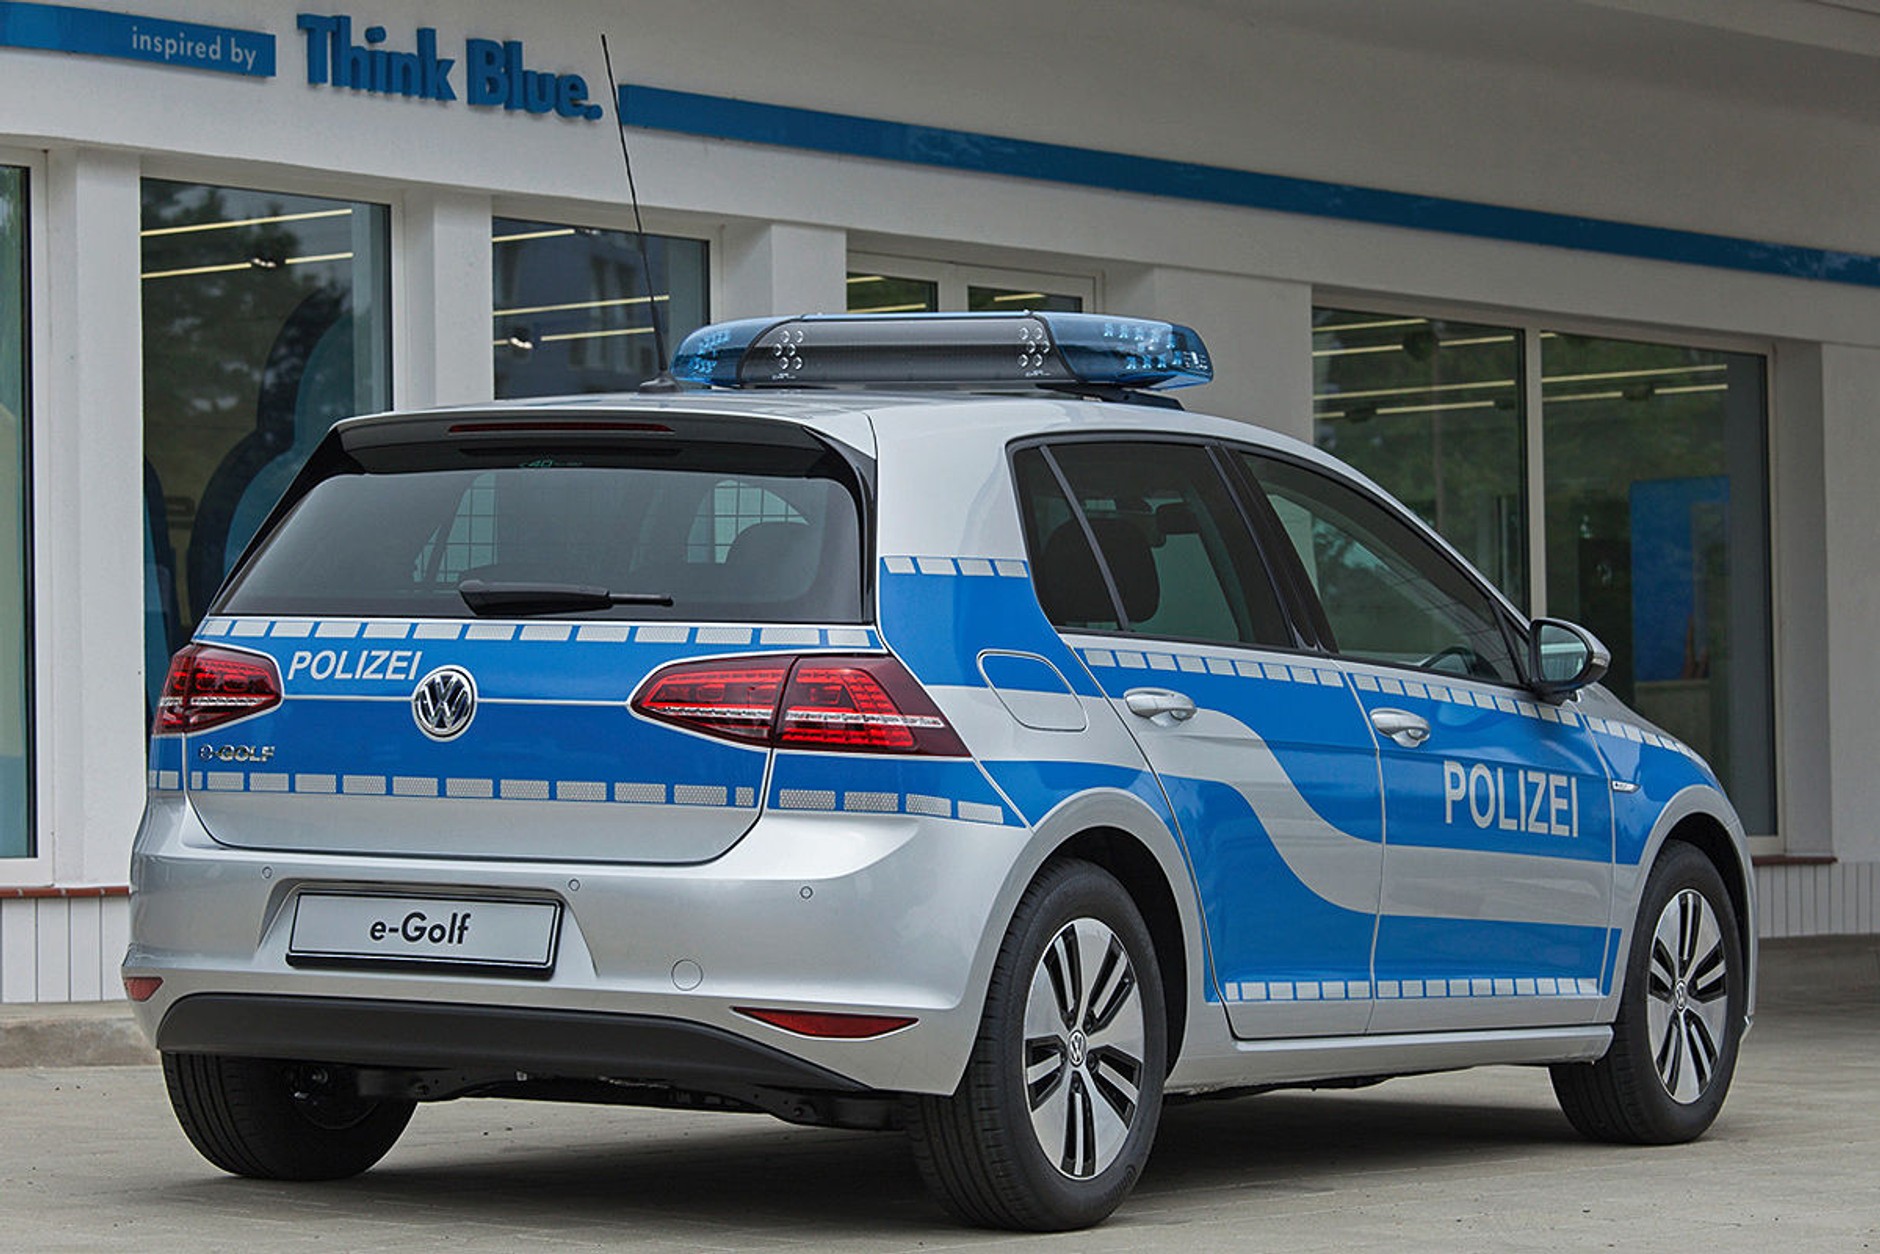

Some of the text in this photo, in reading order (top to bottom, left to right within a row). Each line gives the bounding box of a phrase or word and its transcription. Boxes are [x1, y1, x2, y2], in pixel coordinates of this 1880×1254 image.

[131, 26, 257, 70] inspired by
[297, 14, 603, 120] Think Blue.
[287, 649, 423, 681] POLIZEI
[1443, 760, 1579, 838] POLIZEI
[369, 911, 472, 945] e-Golf
